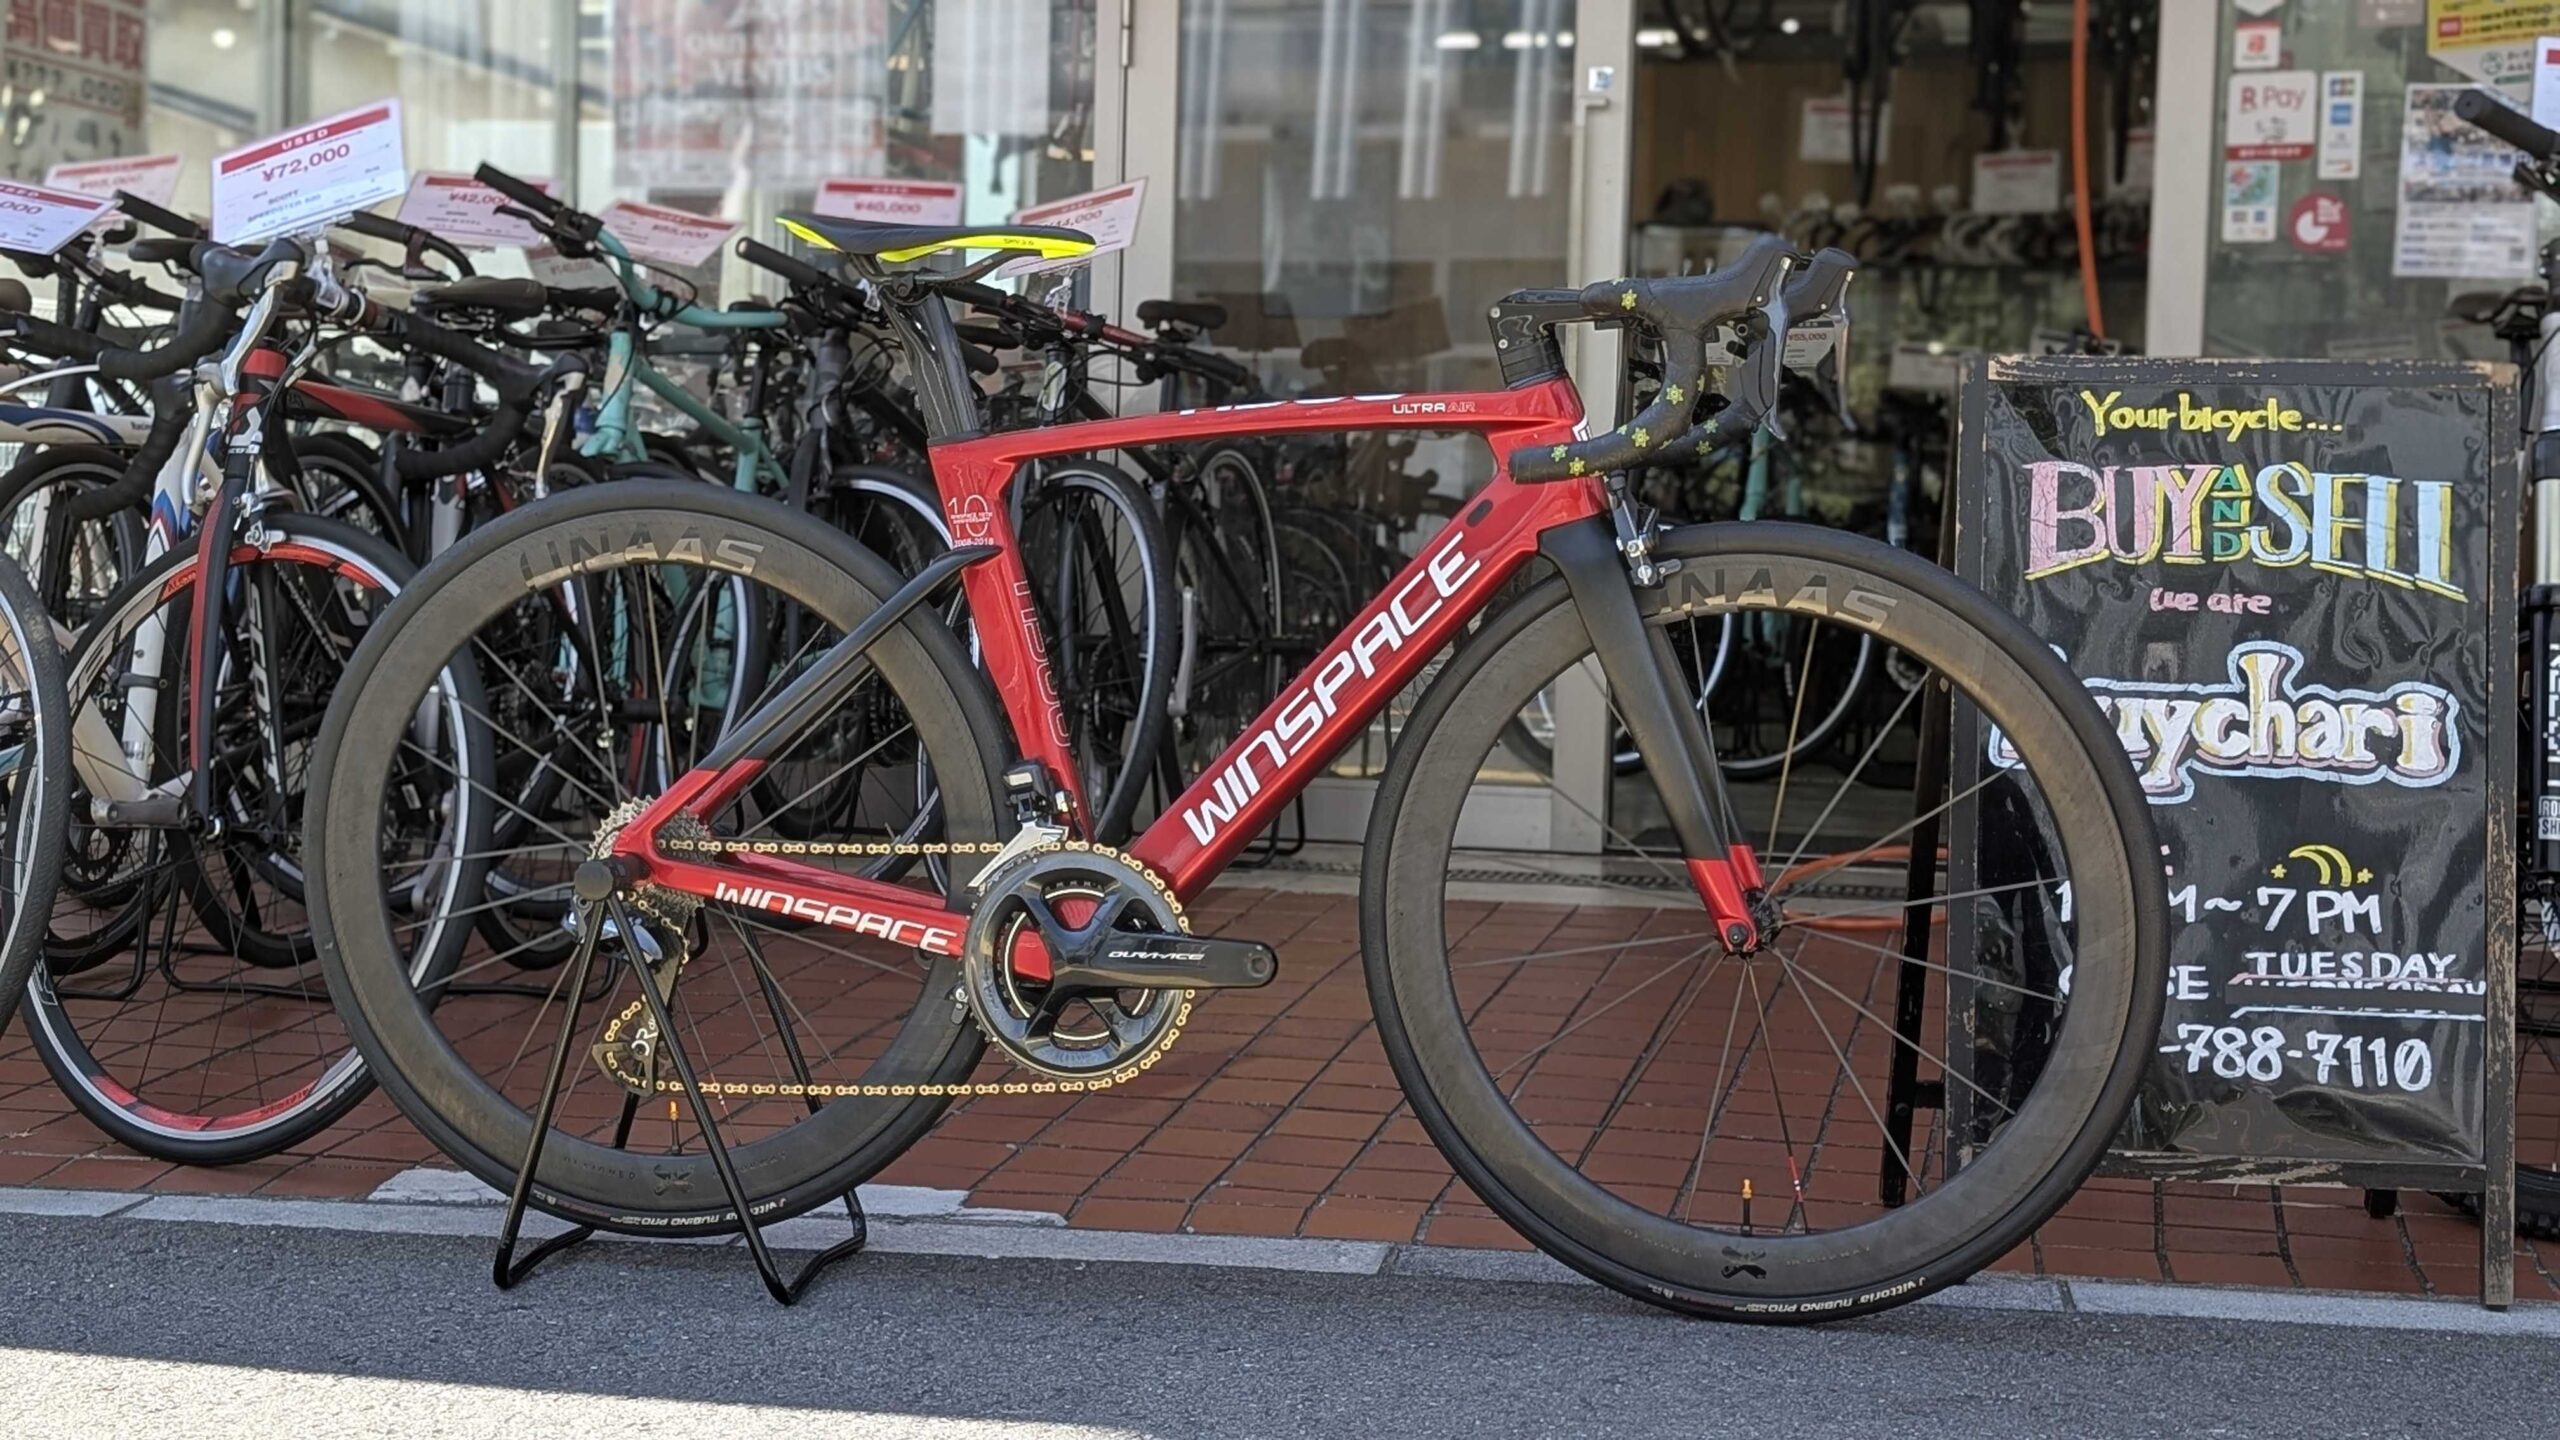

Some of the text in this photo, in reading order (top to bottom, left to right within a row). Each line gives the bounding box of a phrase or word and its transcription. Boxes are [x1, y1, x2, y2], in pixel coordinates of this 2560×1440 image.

[2262, 85, 2307, 109] Pay
[281, 128, 328, 150] USED
[262, 143, 350, 182] ¥72,000
[2080, 391, 2170, 437] Your
[2022, 461, 2468, 603] BUY AND SELL
[2149, 587, 2273, 615] we are
[1182, 530, 1482, 846] WINSPACE
[714, 881, 958, 956] WINSPACE
[2306, 887, 2383, 935] PM
[2244, 950, 2457, 980] TUESDAY
[640, 1216, 668, 1226] PRO
[671, 1213, 720, 1226] RUBINO
[1799, 1298, 1852, 1313] RUBINO
[1859, 1281, 1917, 1304] vittoria
[1768, 1304, 1796, 1313] PRO
